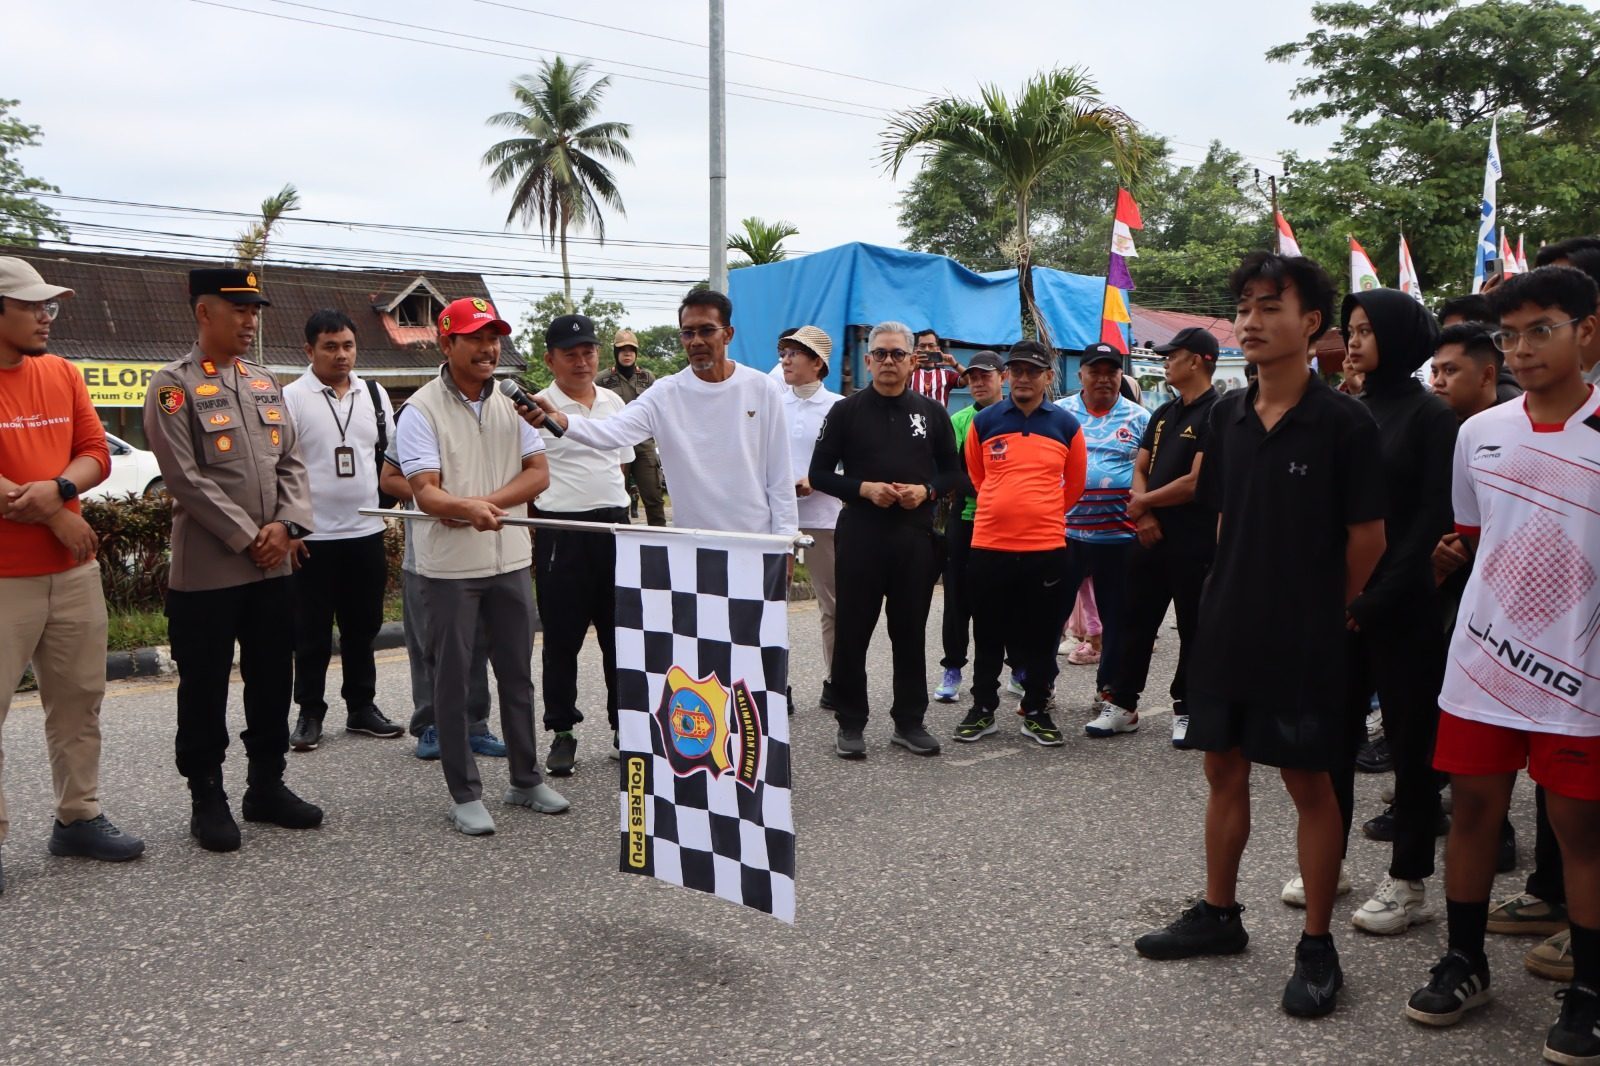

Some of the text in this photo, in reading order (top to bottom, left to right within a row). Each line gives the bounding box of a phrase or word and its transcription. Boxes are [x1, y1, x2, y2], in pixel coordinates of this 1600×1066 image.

[1491, 160, 1501, 173] BRI
[91, 391, 147, 400] rium & P
[255, 395, 279, 404] POLRI
[737, 689, 755, 779] KALIMANTAN TIMUR
[631, 761, 643, 864] POLRES PPU
